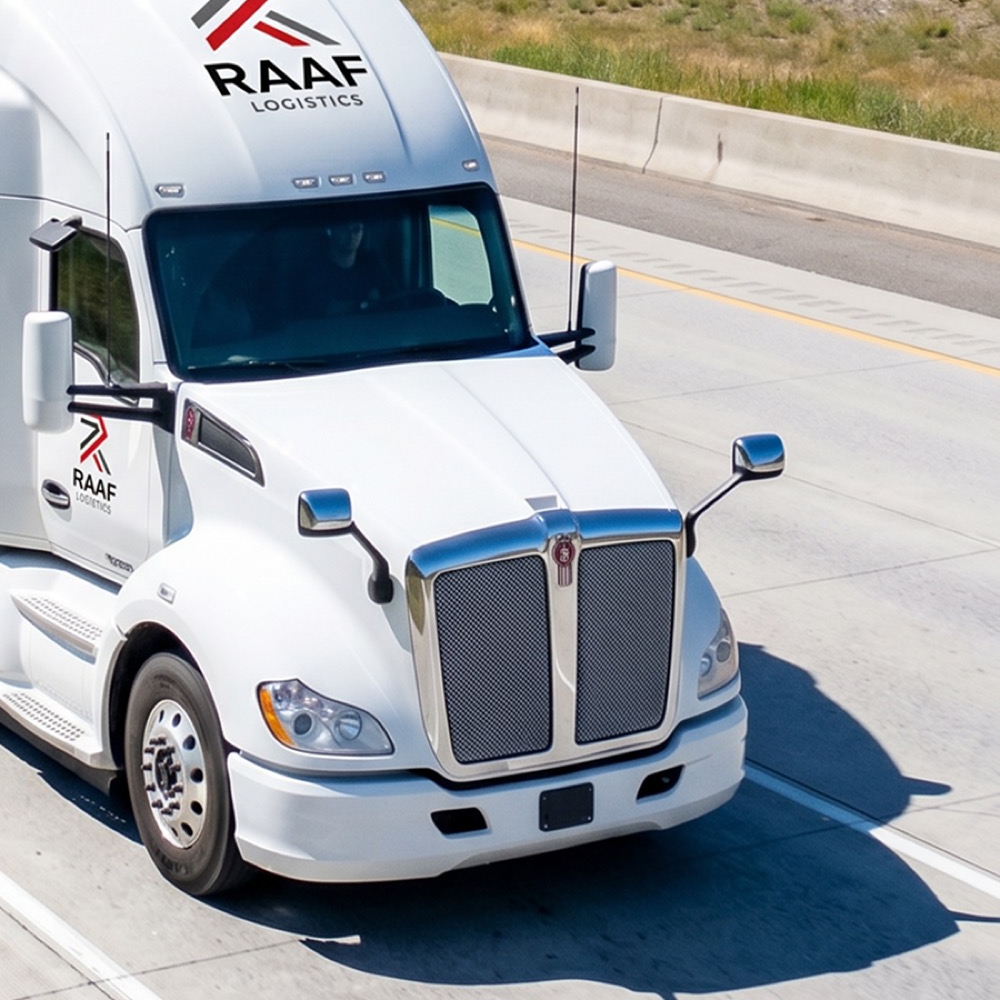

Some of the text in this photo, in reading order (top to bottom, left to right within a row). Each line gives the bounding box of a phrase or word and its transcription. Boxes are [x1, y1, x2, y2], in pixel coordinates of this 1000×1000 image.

[204, 55, 368, 97] RAAF
[250, 94, 364, 113] LOGISTICS
[73, 467, 117, 502] RAAF
